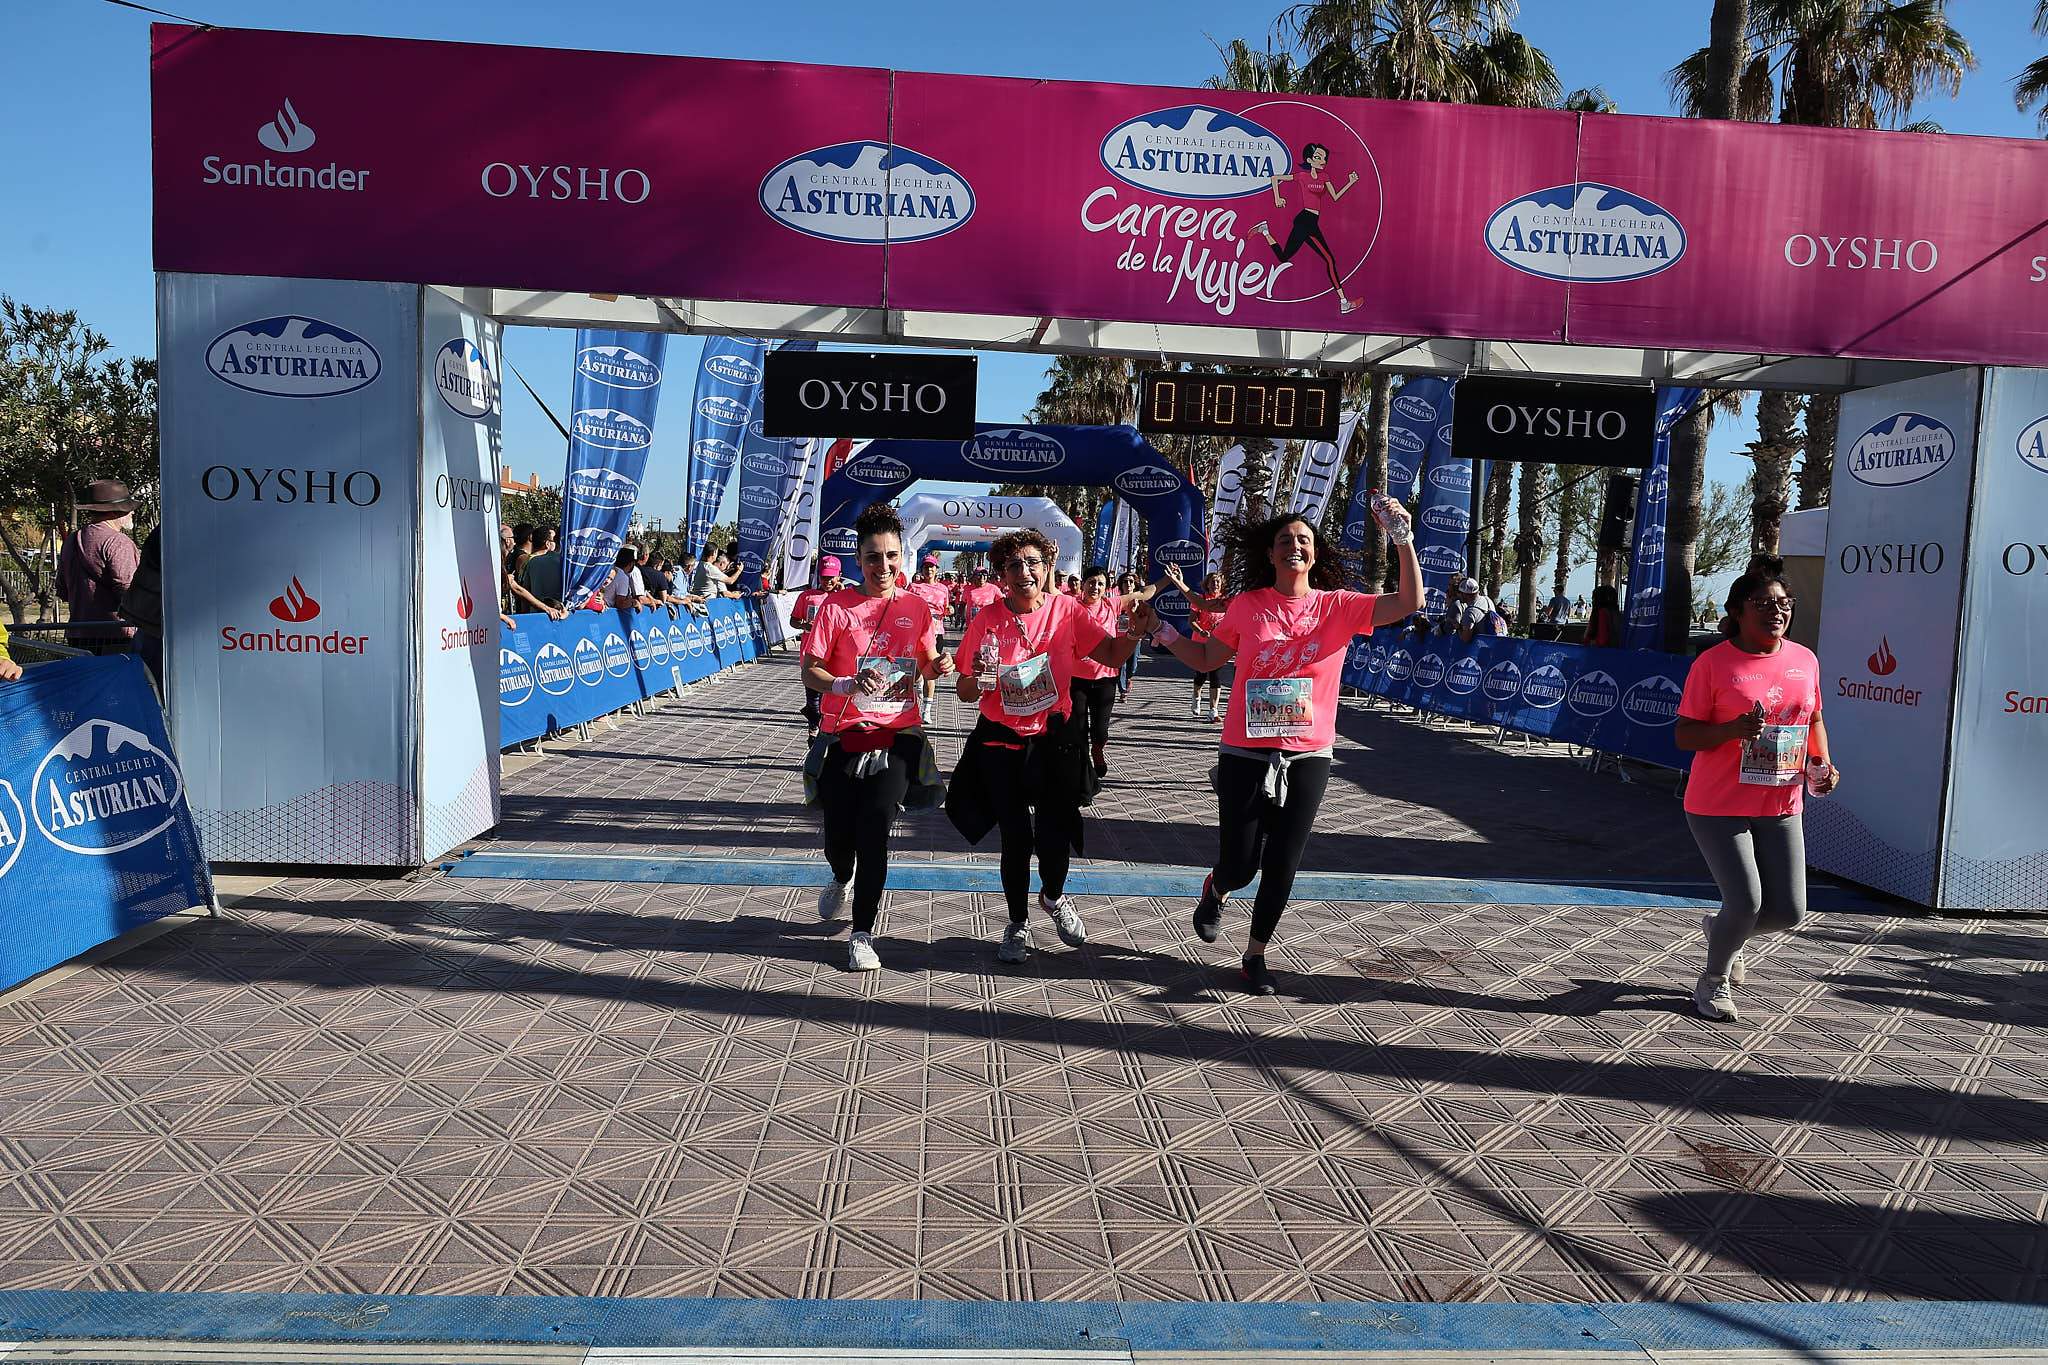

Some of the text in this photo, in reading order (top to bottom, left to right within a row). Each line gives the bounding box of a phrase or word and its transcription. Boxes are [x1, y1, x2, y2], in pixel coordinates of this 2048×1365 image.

[1115, 135, 1275, 178] ASTURIANA
[1146, 135, 1271, 151] CENTRAL LECHERA
[203, 156, 370, 191] Santander
[481, 162, 651, 203] OYSHO
[810, 174, 877, 187] CENTRAL
[776, 175, 958, 219] ASTURIANA
[1081, 186, 1238, 242] Carrera
[1532, 215, 1665, 230] CENTRAL LECHERA
[1499, 215, 1670, 259] ASTURIANA
[1784, 234, 1938, 273] OYSHO
[1117, 238, 1294, 316] de la Mujer
[219, 344, 368, 379] ASTURIANA
[246, 342, 362, 355] CENTRAL LECHERA
[579, 354, 654, 383] ASTURIANA
[709, 360, 758, 382] ASTURIANA
[799, 379, 946, 415] OYSHO
[573, 416, 646, 444] ASTURIANA
[1486, 403, 1626, 440] OYSHO
[968, 442, 1057, 463] ASTURIANA
[1854, 443, 1945, 472] ASTURIANA
[201, 465, 381, 506] OYSHO
[849, 465, 907, 479] ASTURIANA
[1120, 478, 1177, 488] ASTURIANA
[436, 474, 494, 513] OYSHO
[943, 500, 1023, 519] OYSHO
[822, 536, 858, 549] ASTURIA
[1158, 550, 1201, 560] ASTURIAN
[1840, 542, 1944, 574] OYSHO
[1158, 600, 1191, 609] ASTURI
[222, 626, 369, 655] Santander
[441, 627, 488, 651] Santander
[1524, 678, 1561, 699] ASTURIANA
[1571, 685, 1613, 707] ASTURIANA
[1838, 677, 1923, 707] Santander
[65, 764, 112, 784] CENTRAL
[51, 774, 169, 833] ASTURIAN
